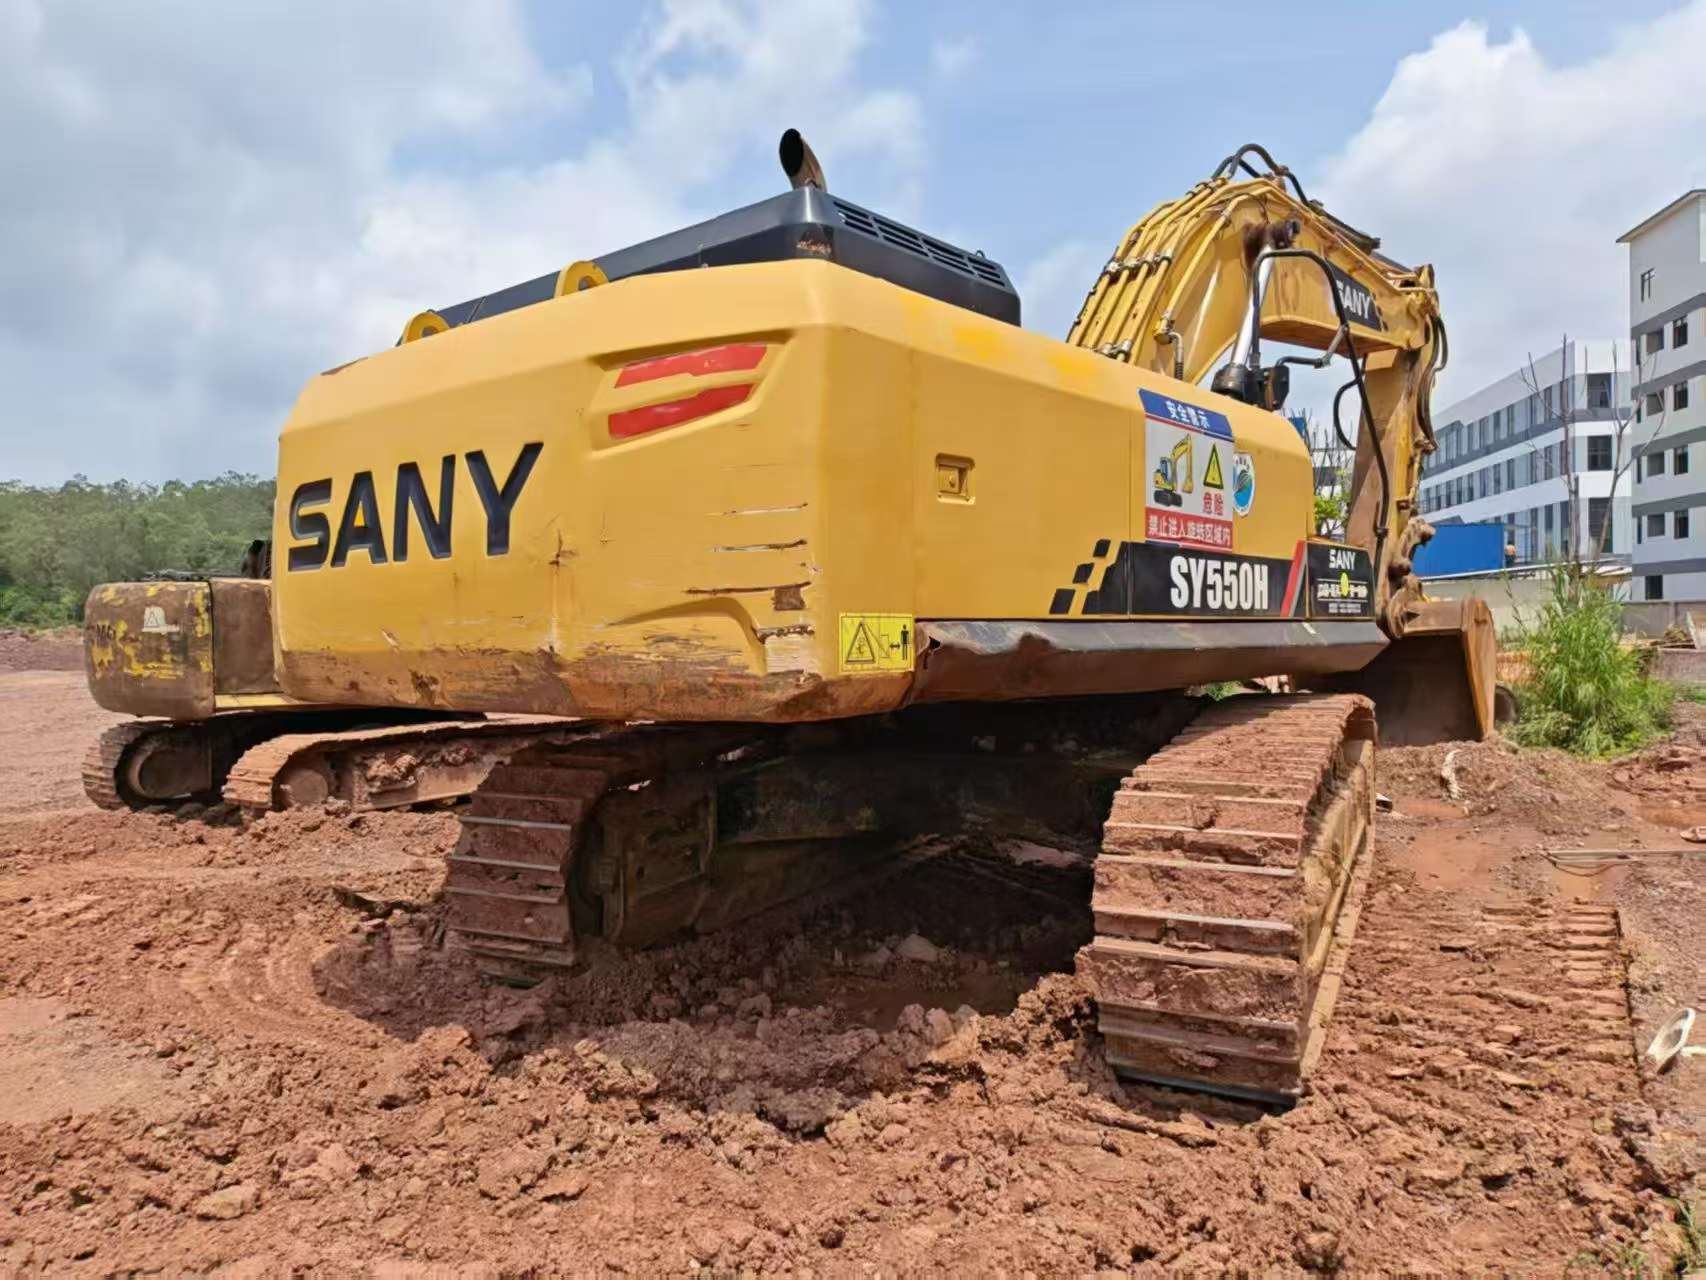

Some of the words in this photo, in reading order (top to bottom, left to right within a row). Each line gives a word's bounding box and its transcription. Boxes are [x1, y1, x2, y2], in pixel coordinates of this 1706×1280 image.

[288, 441, 544, 572] SANY
[1170, 555, 1269, 610] SY550H
[1328, 549, 1356, 570] SANY
